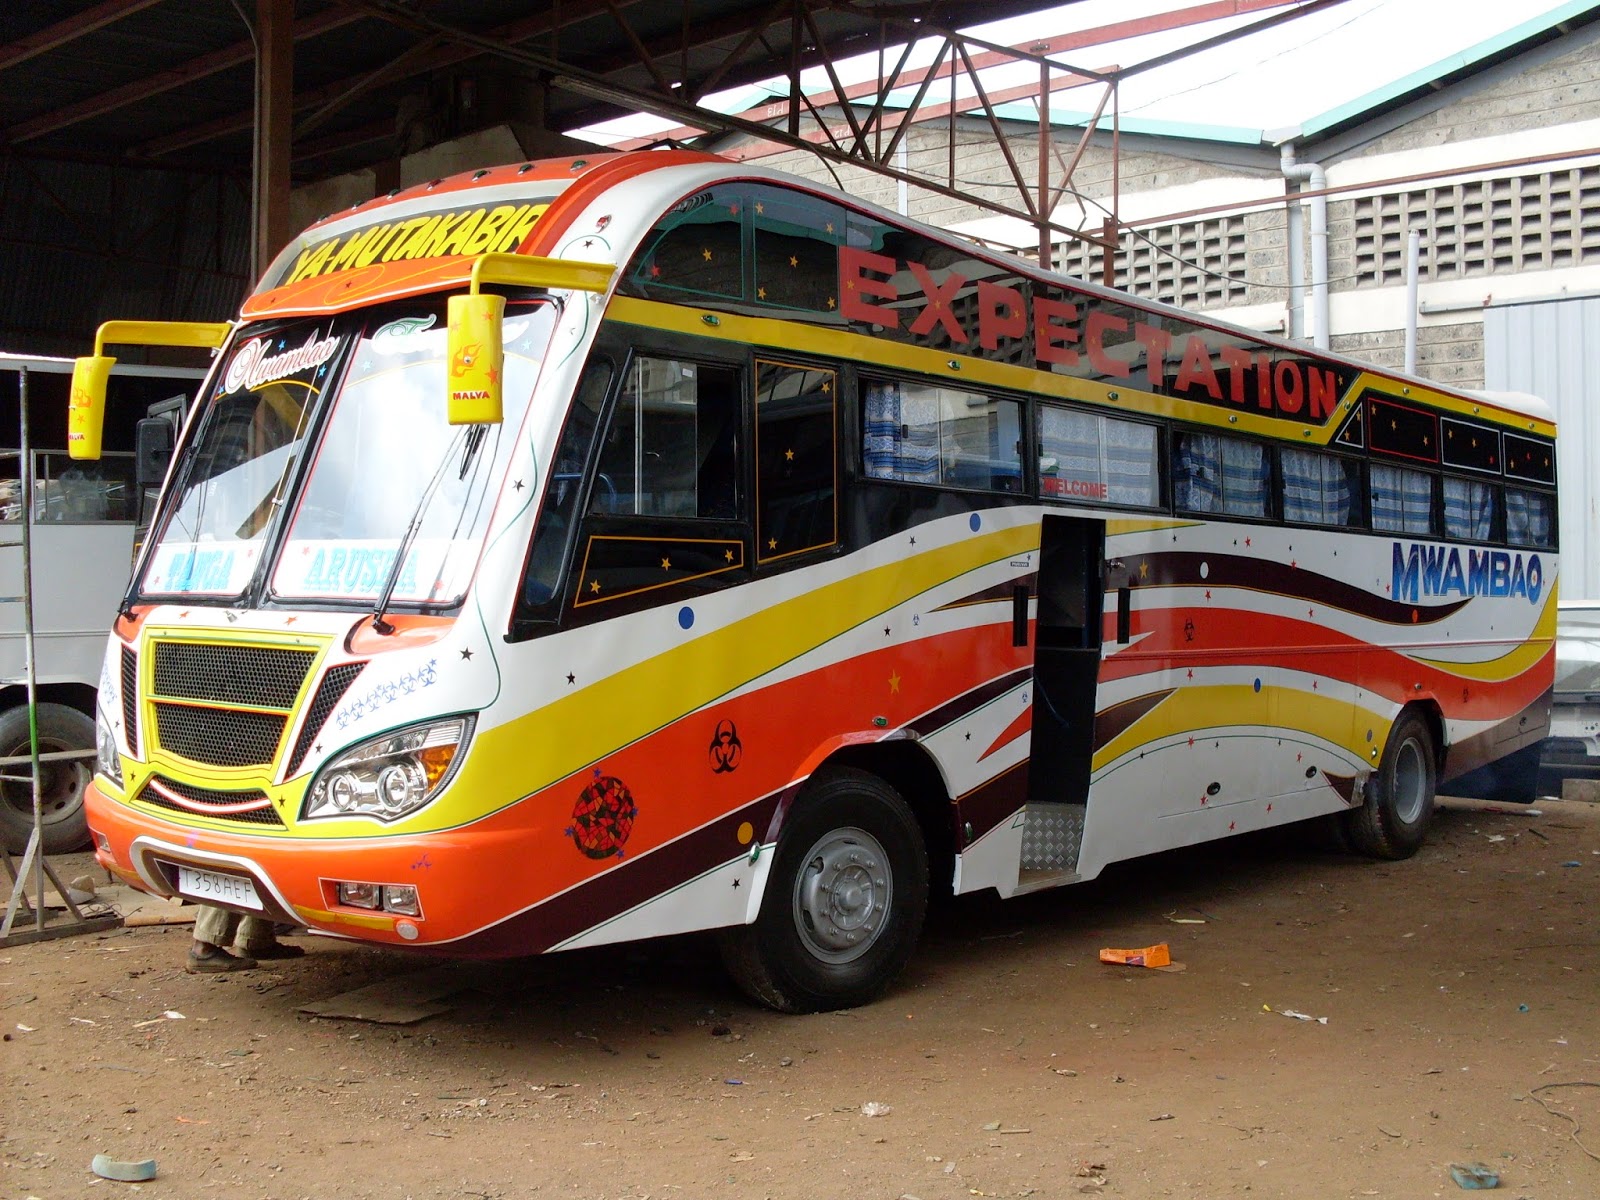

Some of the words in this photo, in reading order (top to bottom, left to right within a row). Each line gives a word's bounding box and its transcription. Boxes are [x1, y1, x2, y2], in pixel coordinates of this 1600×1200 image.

[284, 203, 552, 287] YA-MUTAKABIR
[838, 245, 1338, 419] EXPECTATION
[452, 391, 491, 401] MALVA
[1042, 477, 1108, 499] WELCOME
[1391, 541, 1543, 606] MWAMBAO
